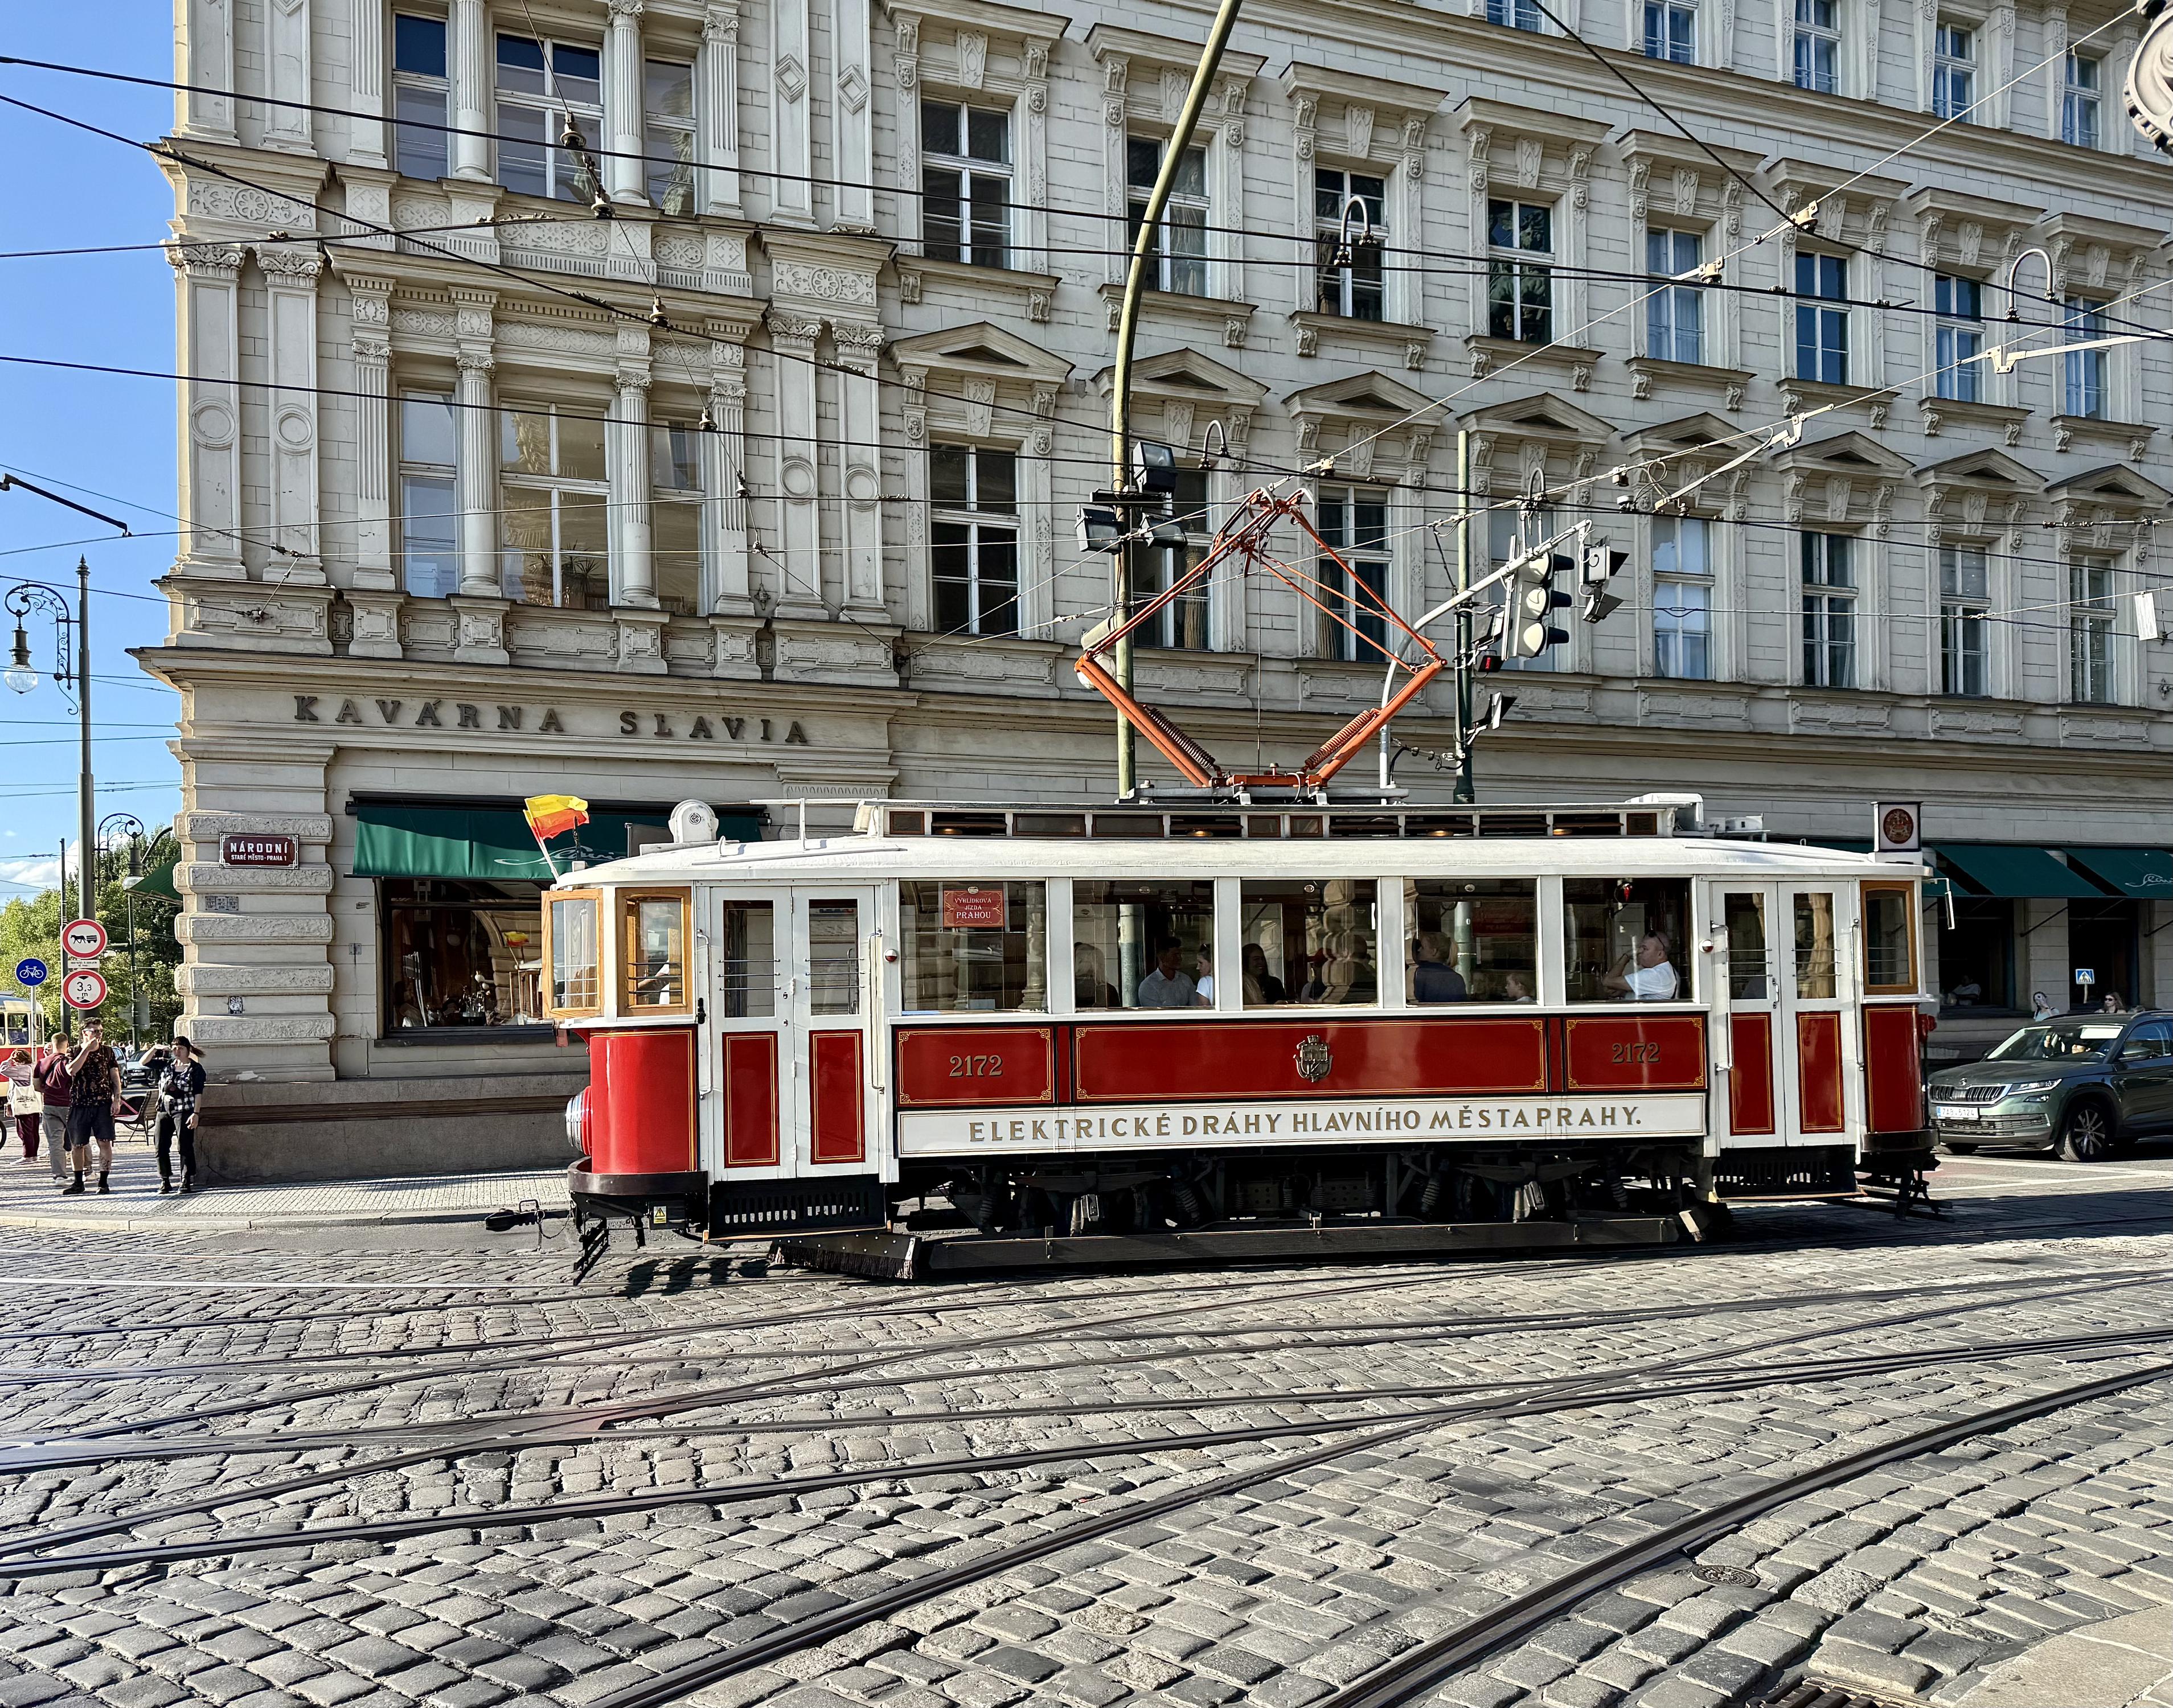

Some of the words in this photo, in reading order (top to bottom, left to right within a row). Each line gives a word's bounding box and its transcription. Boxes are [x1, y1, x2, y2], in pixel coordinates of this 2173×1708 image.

[294, 695, 564, 732] KAVÁRNA
[619, 711, 807, 742] SLAVIA
[230, 841, 288, 853] NÁRODNÍ
[1612, 1042, 1660, 1064] 2172
[949, 1055, 1003, 1077] 2172
[969, 1112, 1171, 1142] ELEKTRICKÉ
[1182, 1111, 1282, 1136] DRÁHY
[1292, 1107, 1421, 1132] HLAVNÍHO
